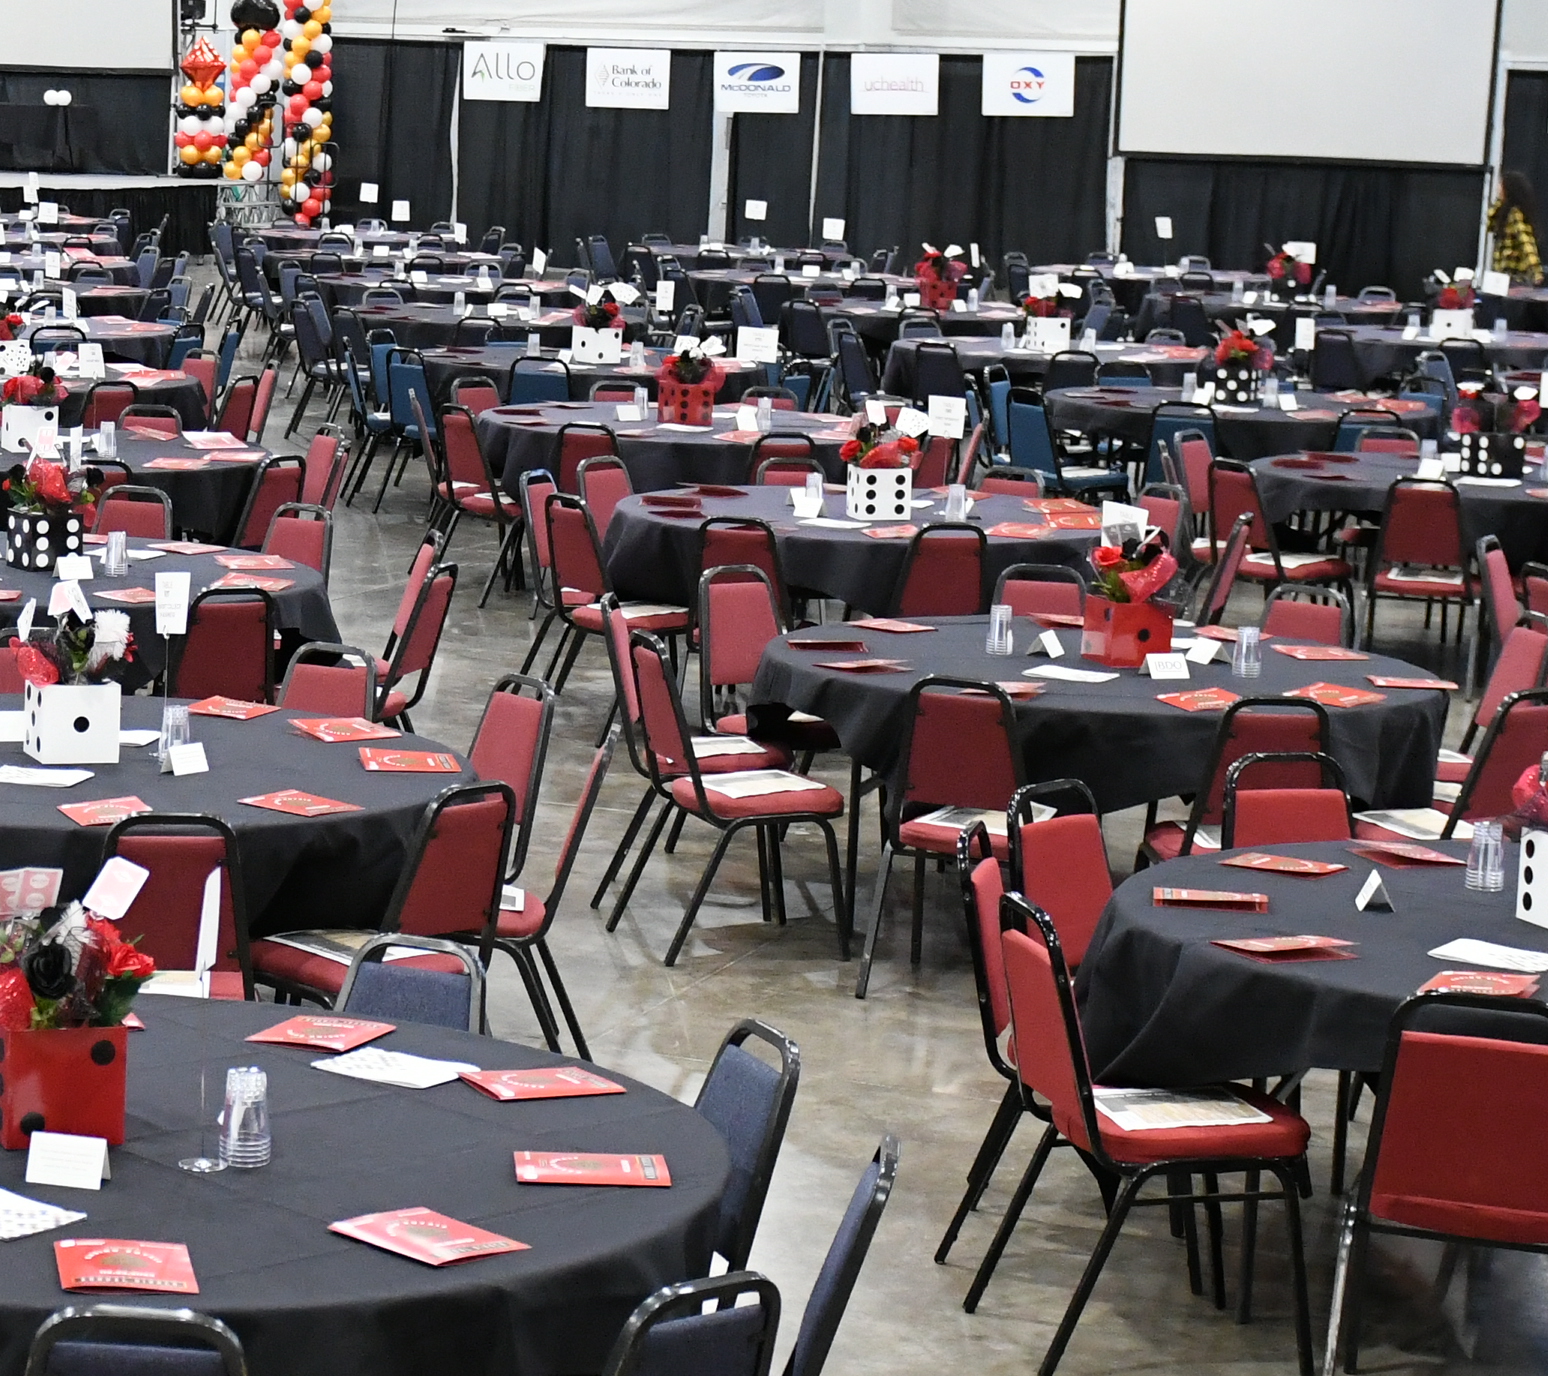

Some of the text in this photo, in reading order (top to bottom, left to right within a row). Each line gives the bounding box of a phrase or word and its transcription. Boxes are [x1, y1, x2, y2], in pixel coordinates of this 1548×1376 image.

[471, 52, 536, 82] Allo
[612, 64, 653, 76] Bank of
[612, 77, 662, 89] Colorado
[864, 77, 924, 92] uchealth
[1010, 80, 1045, 91] OXY
[1158, 660, 1183, 670] BDO
